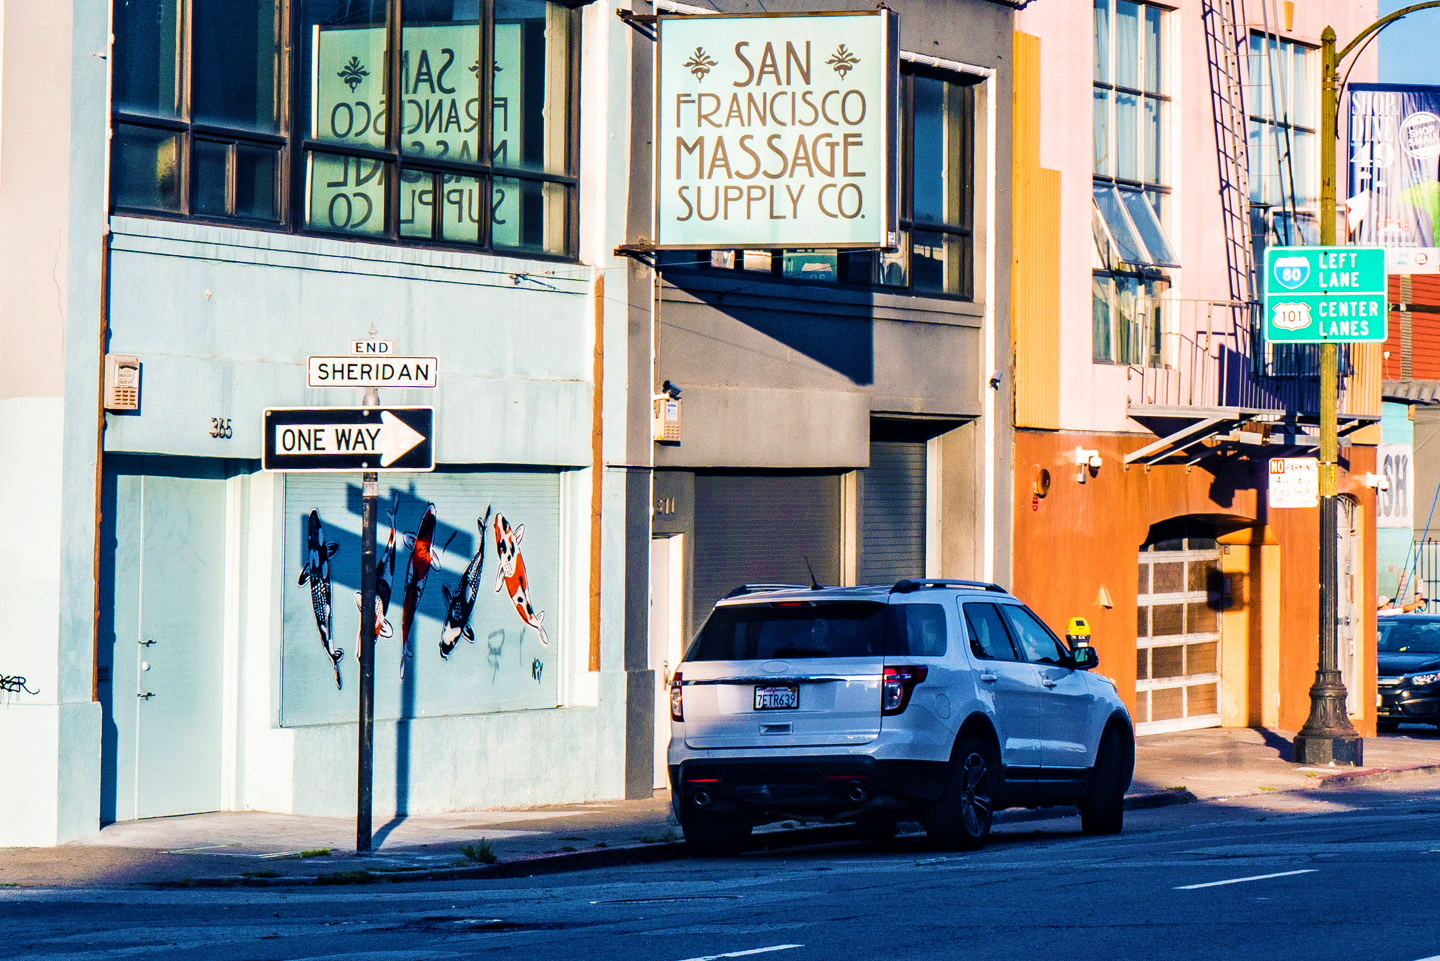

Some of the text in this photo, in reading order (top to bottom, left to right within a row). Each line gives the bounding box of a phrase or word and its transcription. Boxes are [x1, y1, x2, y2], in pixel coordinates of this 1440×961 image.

[732, 40, 811, 87] SAN
[676, 89, 867, 129] FRANCISCO
[675, 132, 867, 180] MASSAGE
[676, 183, 866, 222] SUPPLY CO.
[1319, 253, 1357, 269] LEFT
[1282, 268, 1302, 282] 80
[1319, 272, 1359, 288] LANE
[1282, 310, 1302, 322] 101
[1319, 301, 1379, 317] CENTER
[1319, 320, 1369, 336] LANES
[355, 342, 389, 353] END
[317, 363, 429, 381] SHERIDAN
[282, 428, 381, 451] ONE WAY
[1271, 460, 1284, 473] NO
[1377, 453, 1408, 517] SH
[757, 693, 796, 707] 7ETR639
